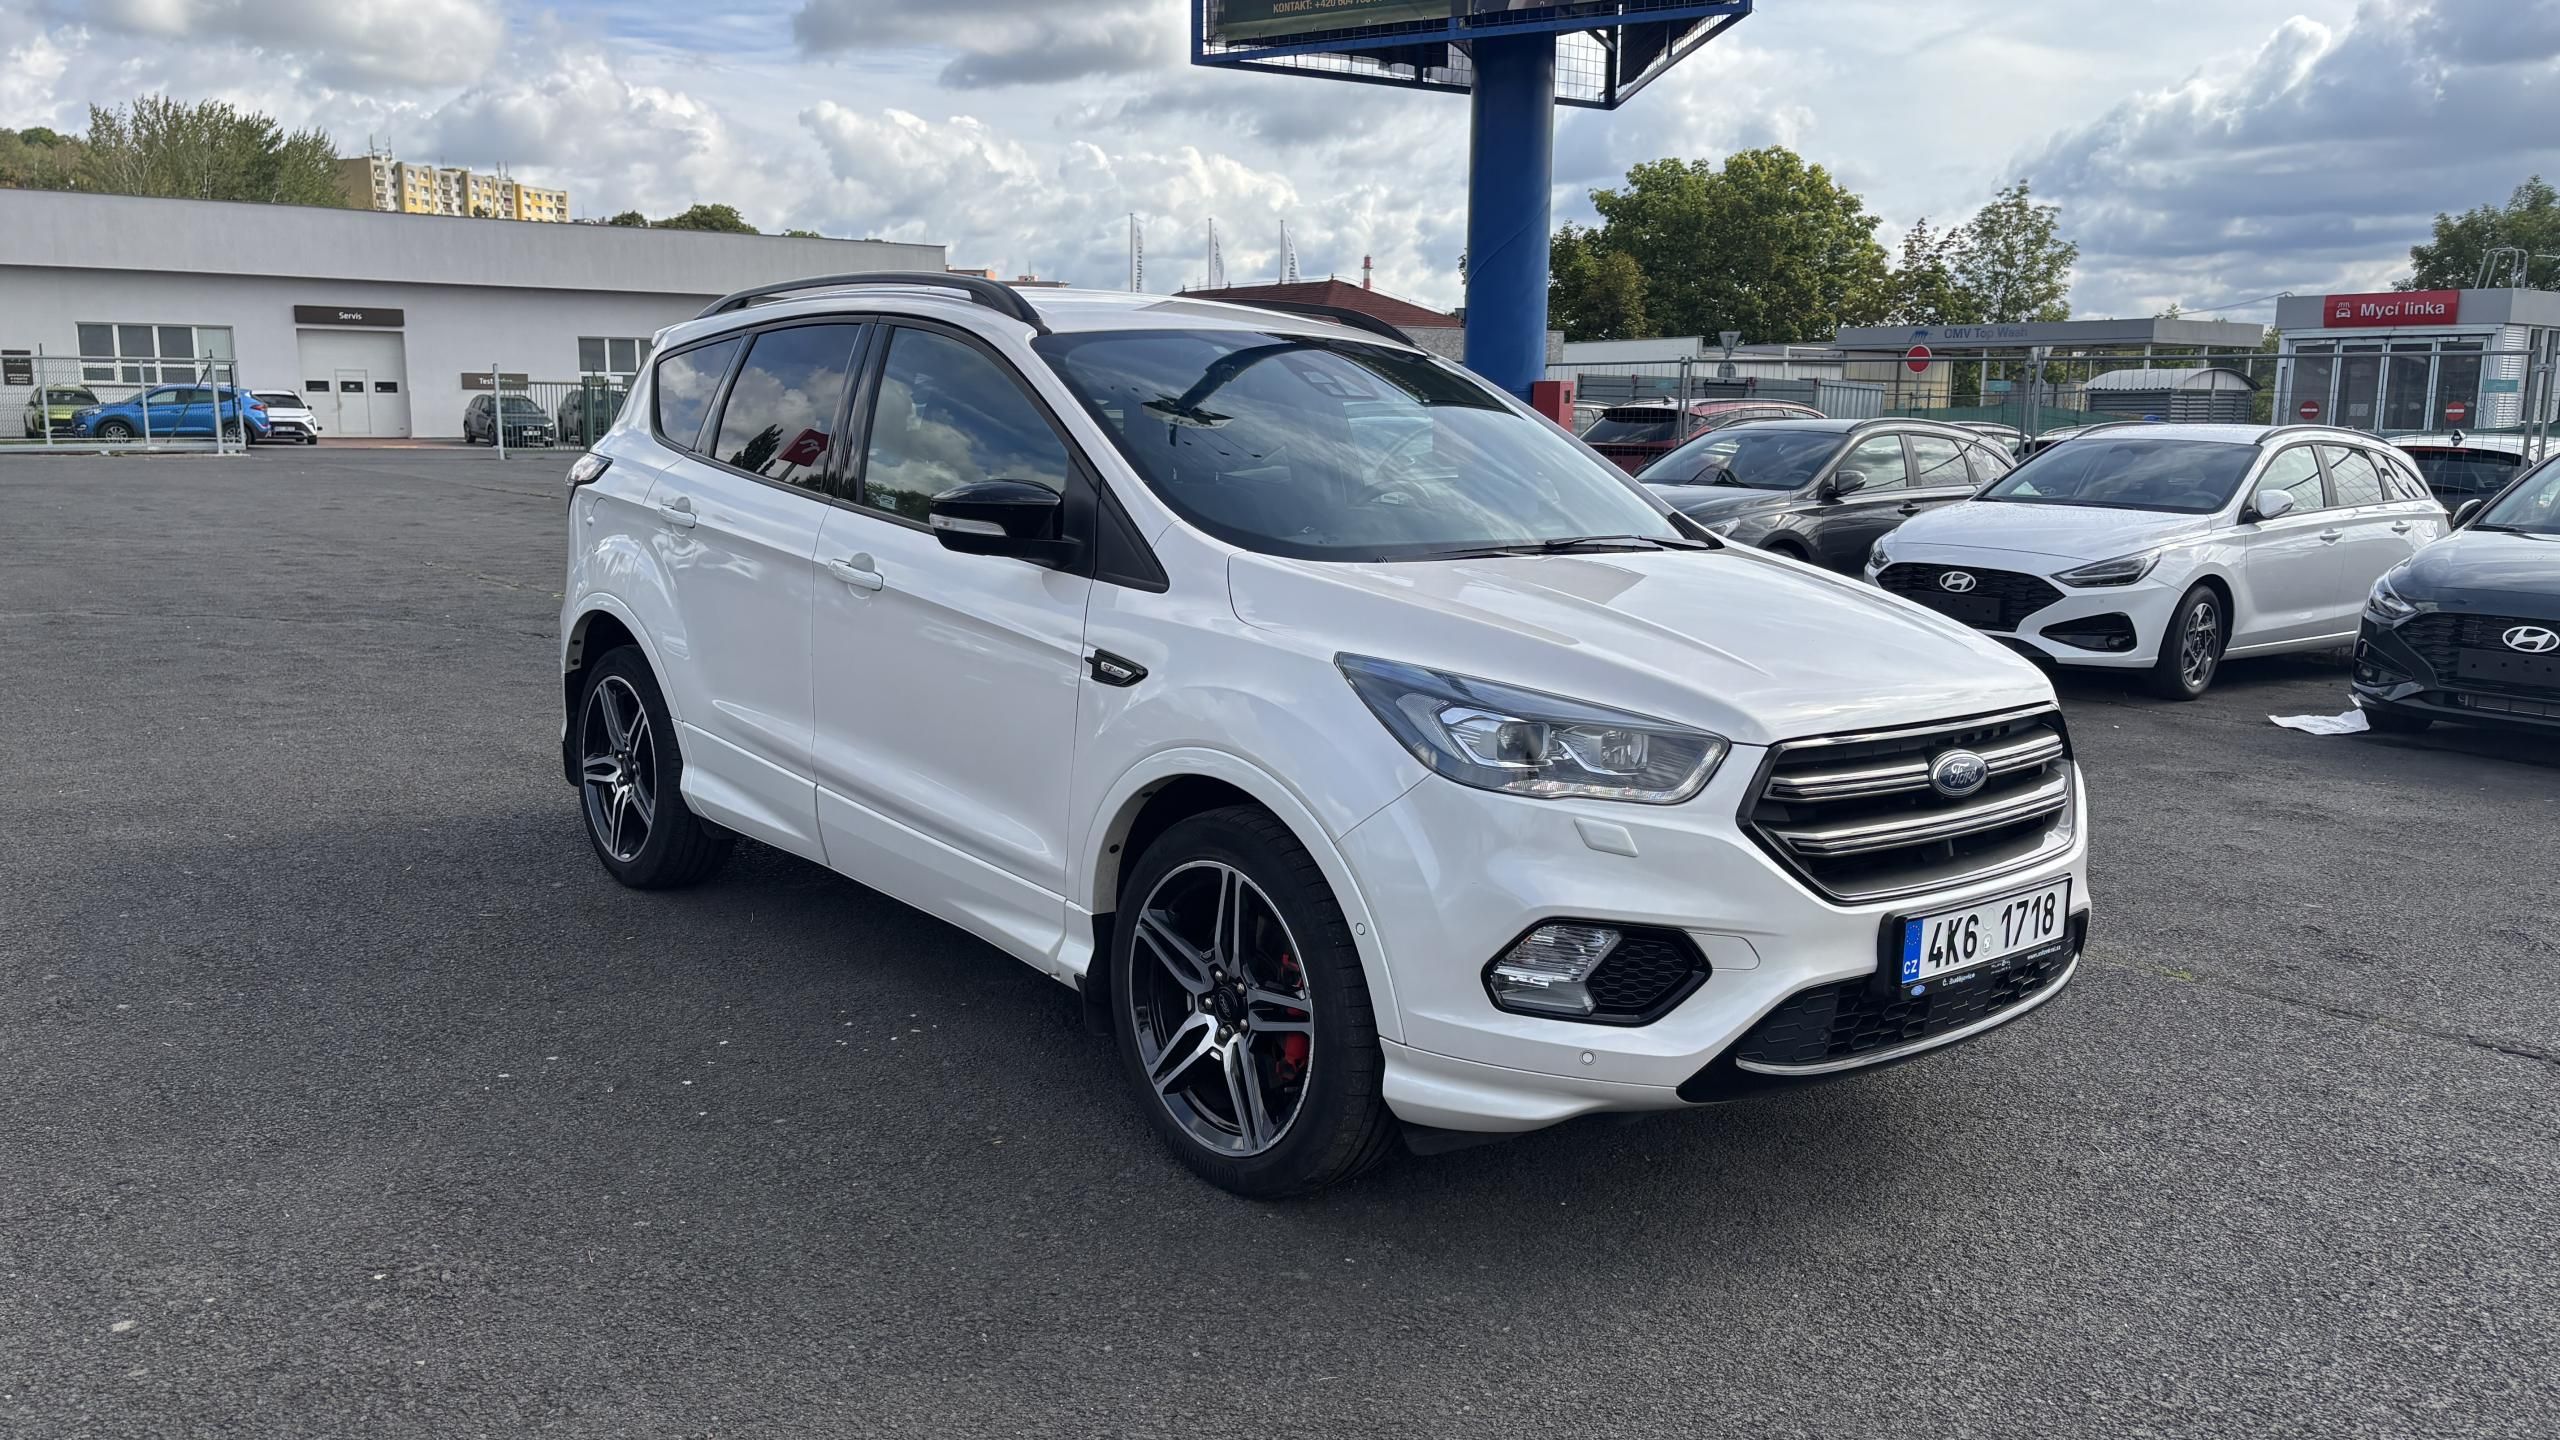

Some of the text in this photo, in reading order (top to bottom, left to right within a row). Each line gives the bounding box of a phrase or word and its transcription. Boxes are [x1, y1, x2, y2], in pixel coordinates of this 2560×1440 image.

[1273, 1, 1313, 14] KONTAKT:
[338, 311, 363, 320] Servis
[2360, 301, 2445, 320] Mycí linka
[1944, 327, 2028, 340] OMV Top Wash
[479, 377, 493, 385] Test
[1950, 762, 1978, 786] Ford
[1928, 892, 2056, 968] 4K6 1718
[1903, 960, 1918, 975] CZ
